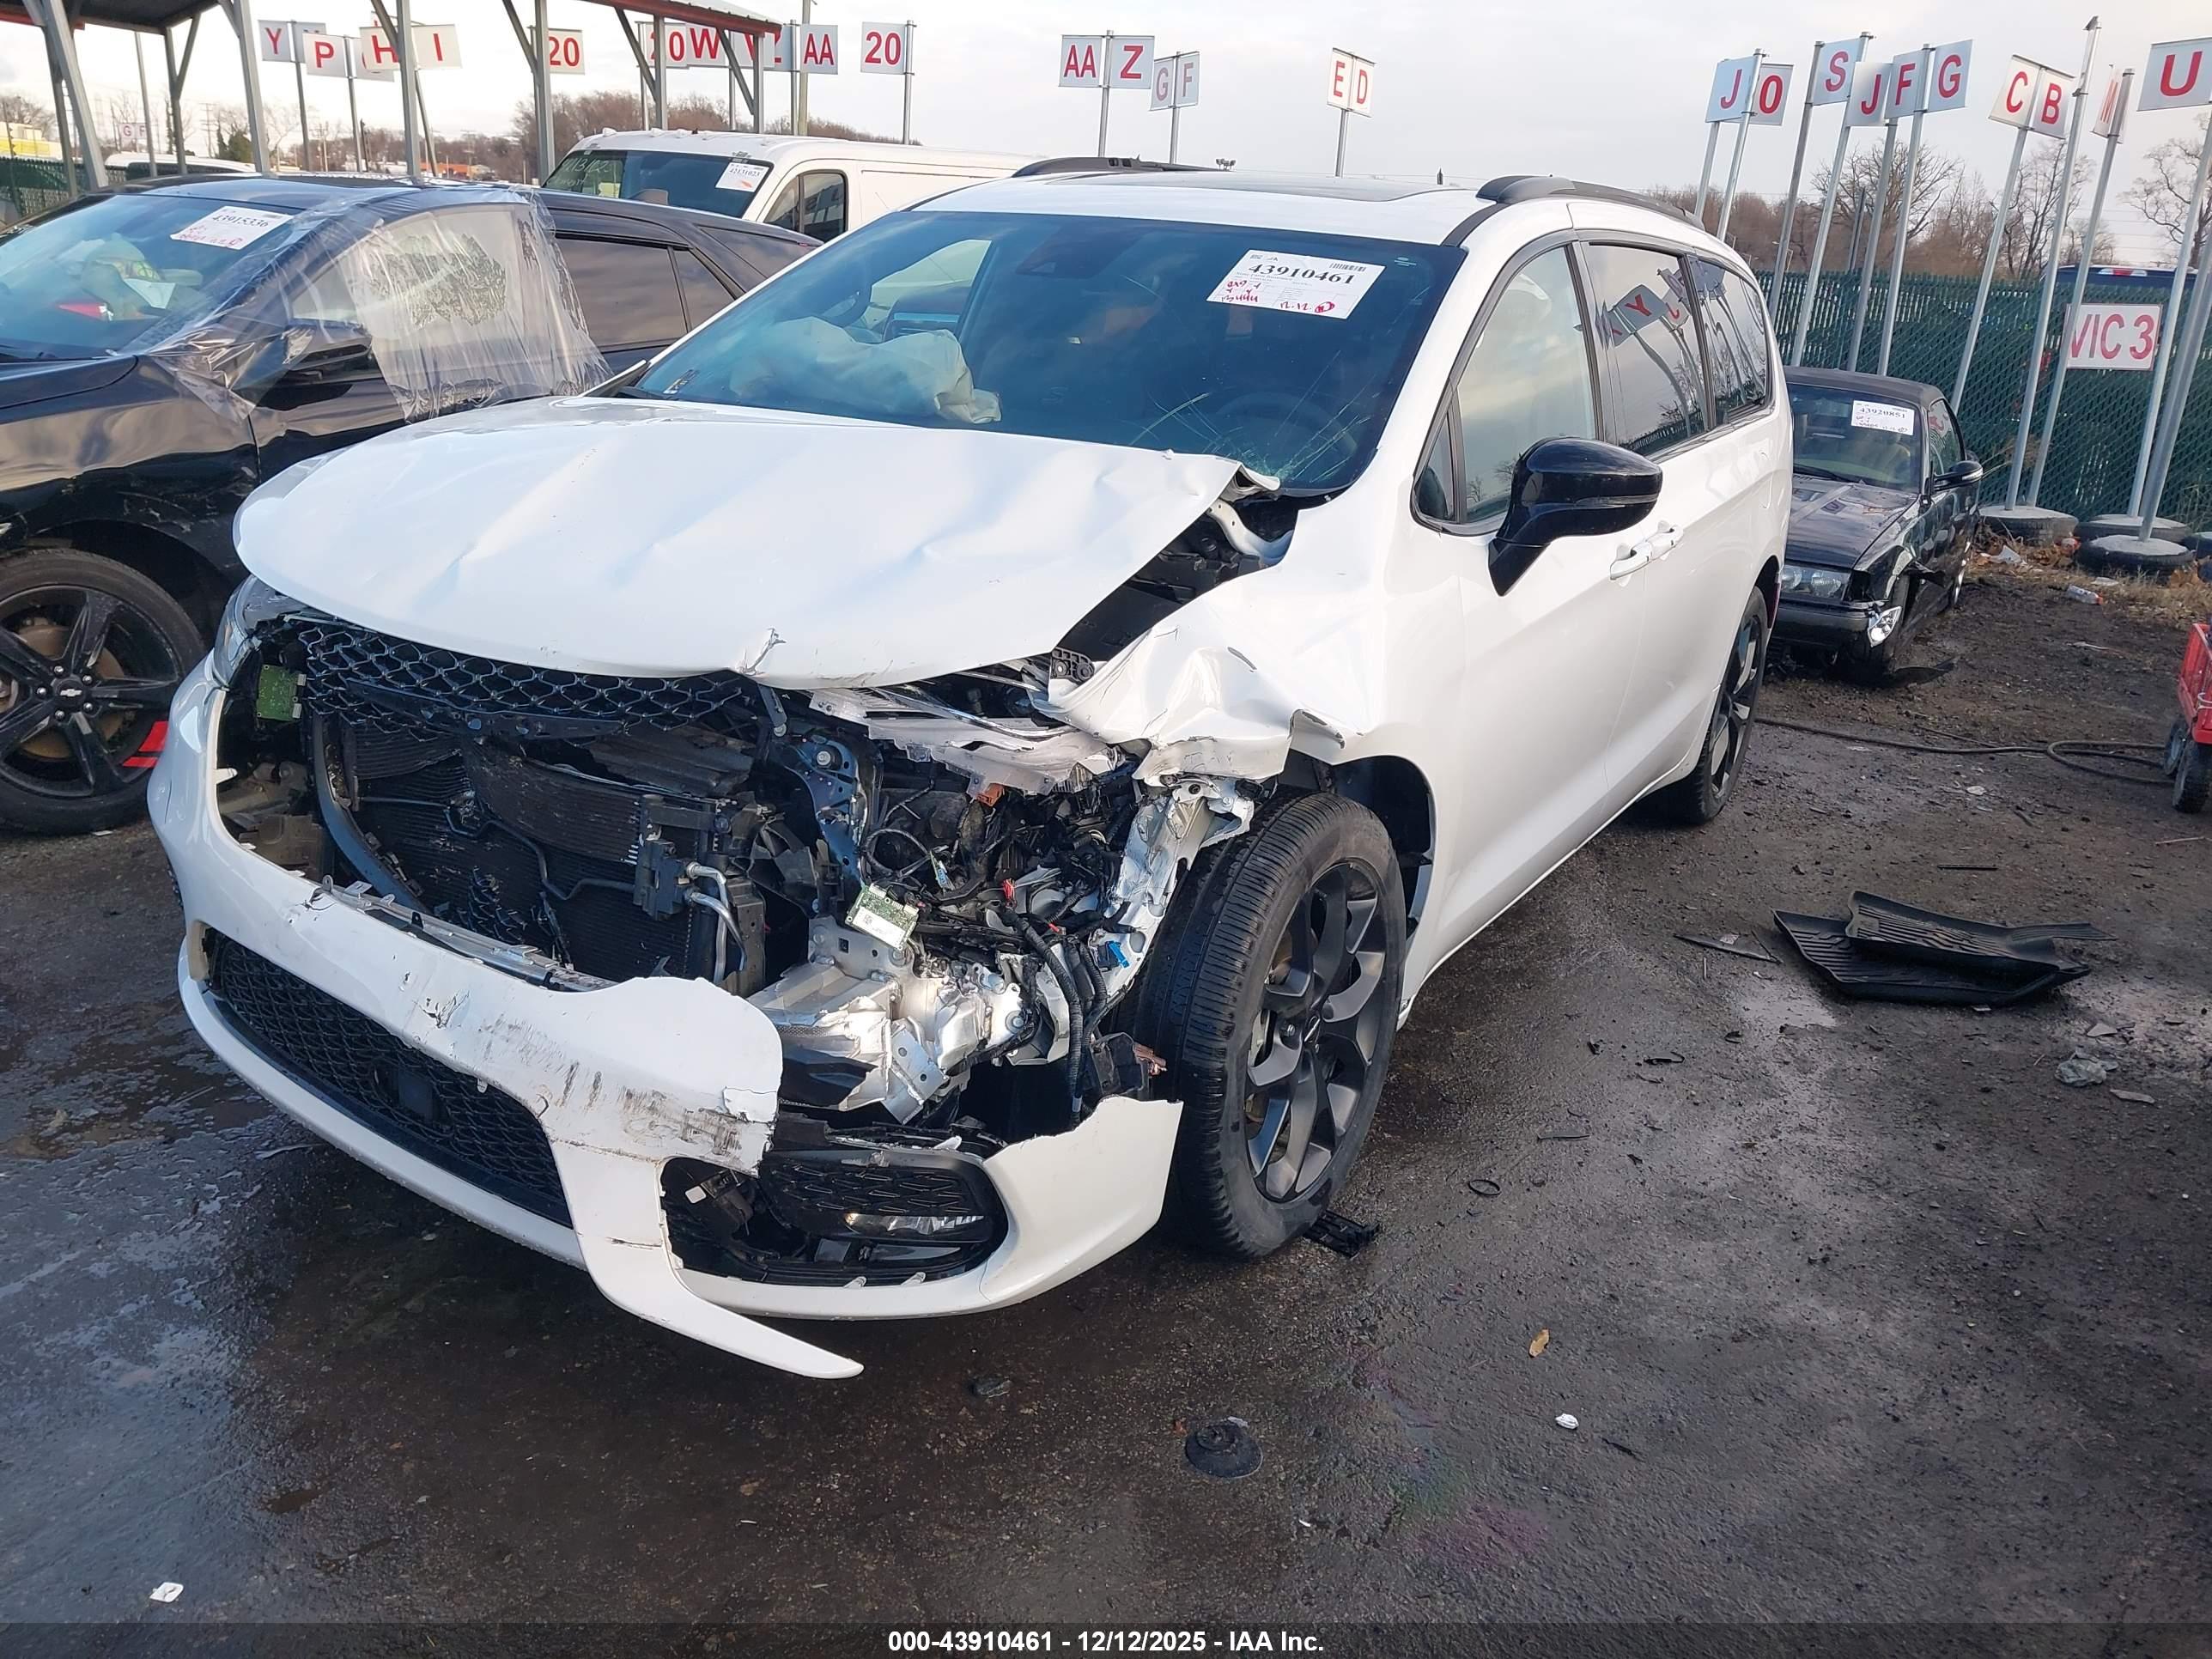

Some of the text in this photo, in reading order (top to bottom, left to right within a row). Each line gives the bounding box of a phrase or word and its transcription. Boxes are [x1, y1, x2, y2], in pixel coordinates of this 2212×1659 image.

[265, 27, 282, 54] Y
[314, 41, 334, 68] P
[372, 34, 399, 64] H
[433, 33, 443, 61] I
[548, 36, 580, 67] 20
[690, 27, 720, 59] W
[803, 33, 835, 65] AA
[865, 31, 902, 65] 20
[1063, 45, 1097, 78] AA
[1120, 45, 1144, 79] Z
[1825, 51, 1850, 93] S
[1938, 54, 1962, 99] G
[2160, 51, 2203, 96] U
[1156, 67, 1169, 101] G
[1182, 62, 1194, 97] F
[1334, 60, 1346, 98] E
[1357, 69, 1368, 104] D
[1720, 69, 1742, 109] J
[1861, 74, 1881, 115] J
[1894, 63, 1916, 106] F
[2005, 70, 2028, 113] C
[2041, 82, 2062, 125] B
[1248, 264, 1355, 285] 43910461
[2071, 313, 2154, 360] VIC 3
